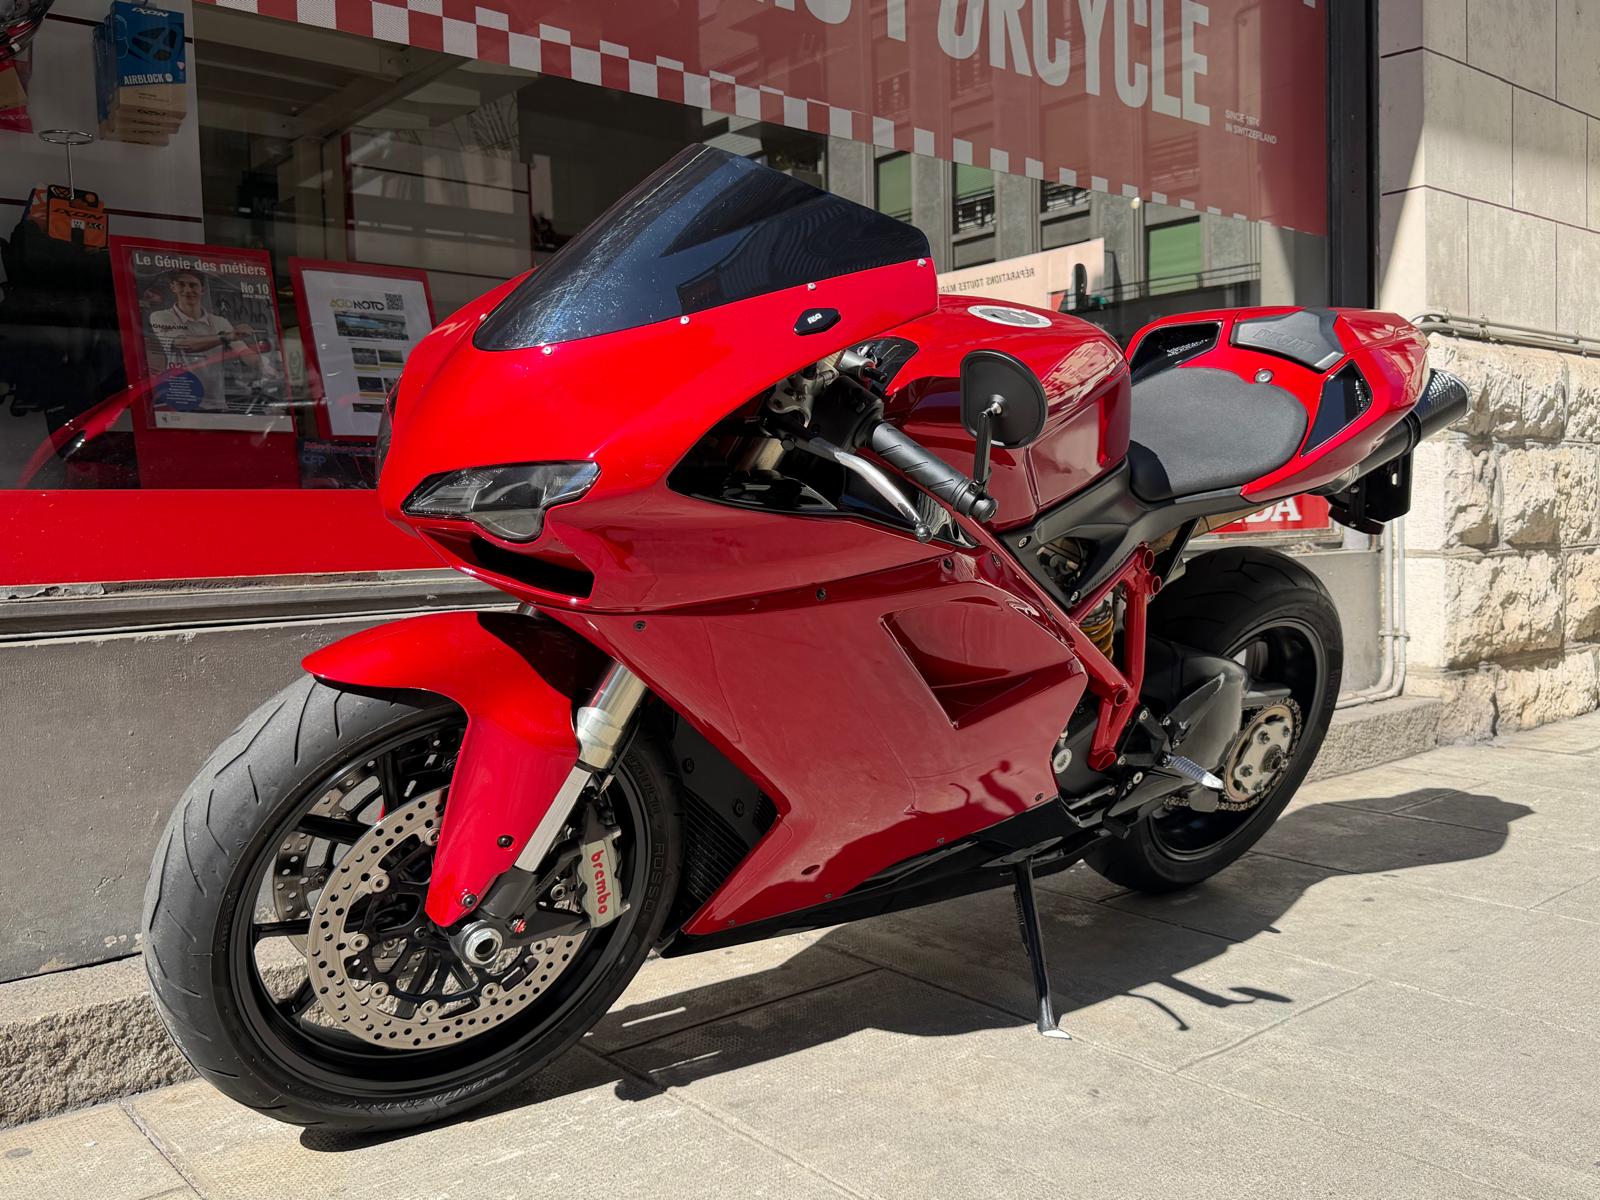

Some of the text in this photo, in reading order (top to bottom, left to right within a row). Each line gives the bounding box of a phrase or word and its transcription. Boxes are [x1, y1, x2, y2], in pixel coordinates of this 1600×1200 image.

[123, 73, 165, 85] AIRBLOCK
[1224, 109, 1245, 123] SINCE
[1225, 122, 1277, 144] IN SWITZERLAND
[54, 208, 103, 219] IXON
[135, 253, 267, 276] Le Génie des métiers
[240, 281, 269, 295] No 10
[591, 849, 611, 914] brembo
